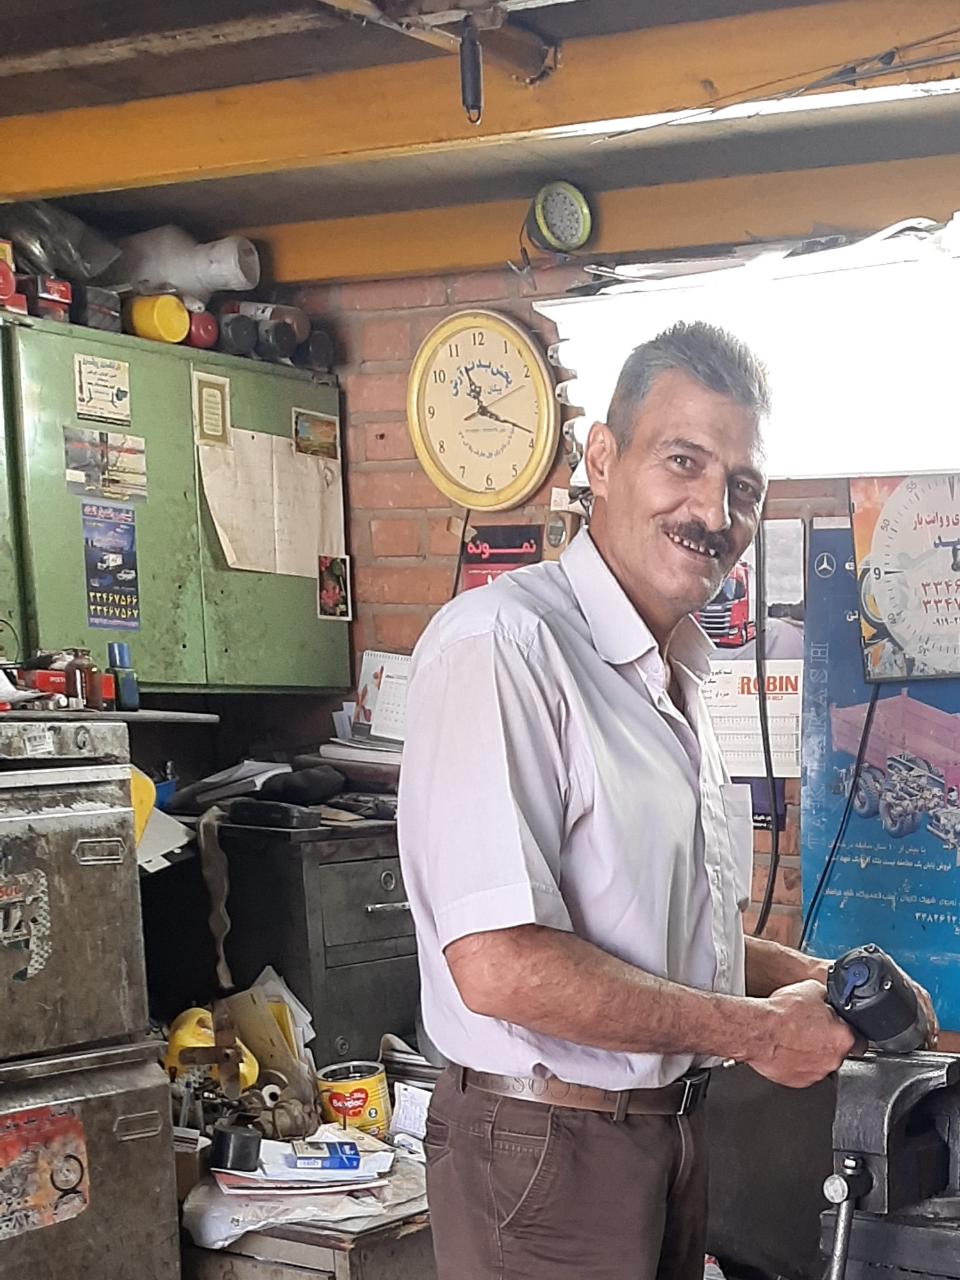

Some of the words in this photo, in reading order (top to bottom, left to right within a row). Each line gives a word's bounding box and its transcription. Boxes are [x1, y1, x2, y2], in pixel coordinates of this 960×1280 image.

[473, 332, 485, 346] 12
[449, 344, 459, 357] 11
[433, 370, 446, 383] 10
[525, 365, 530, 378] 2
[428, 406, 435, 418] 9
[439, 441, 446, 453] 8
[529, 438, 535, 448] 4
[459, 466, 466, 479] 7
[511, 464, 518, 477] 5
[485, 474, 493, 487] 6
[467, 539, 536, 559] نمونه
[873, 567, 881, 580] 9
